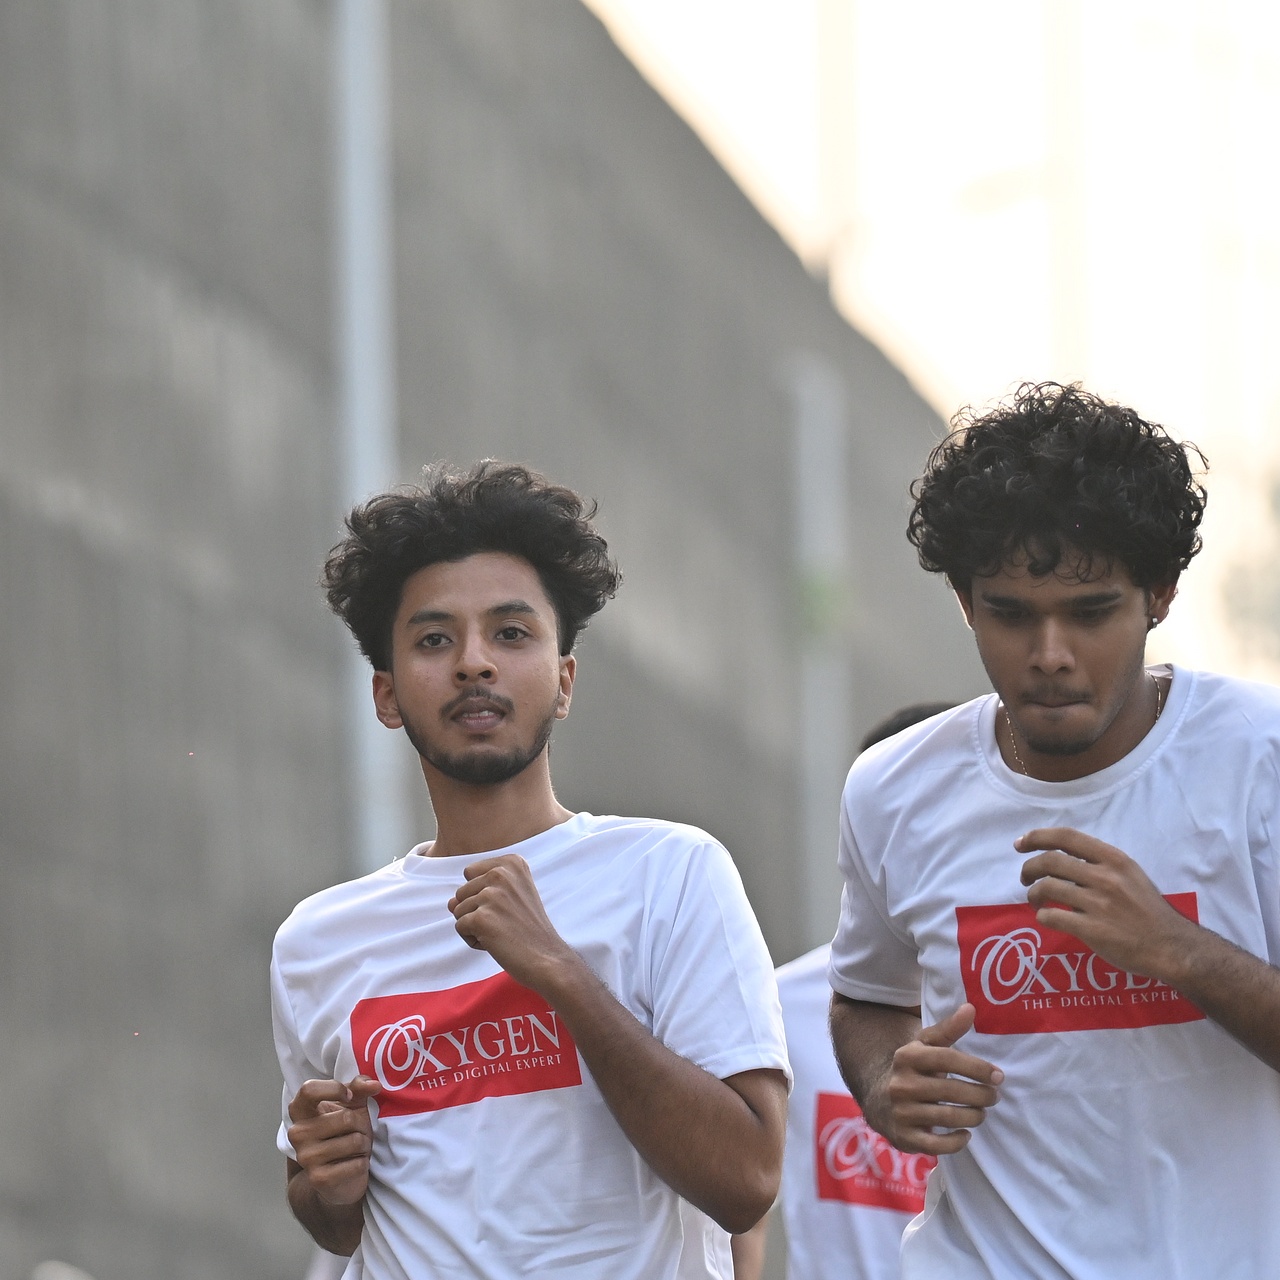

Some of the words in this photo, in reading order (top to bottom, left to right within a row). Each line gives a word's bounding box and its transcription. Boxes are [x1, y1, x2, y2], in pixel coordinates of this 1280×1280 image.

[971, 926, 1168, 1006] OXYG
[1022, 998, 1053, 1011] THE
[1061, 994, 1123, 1008] DIGITAL
[1131, 989, 1180, 1004] EXPER
[364, 1011, 561, 1092] OXYGEN
[417, 1075, 447, 1092] THE
[454, 1061, 513, 1084] DIGITAL
[516, 1053, 562, 1072] EXPERT
